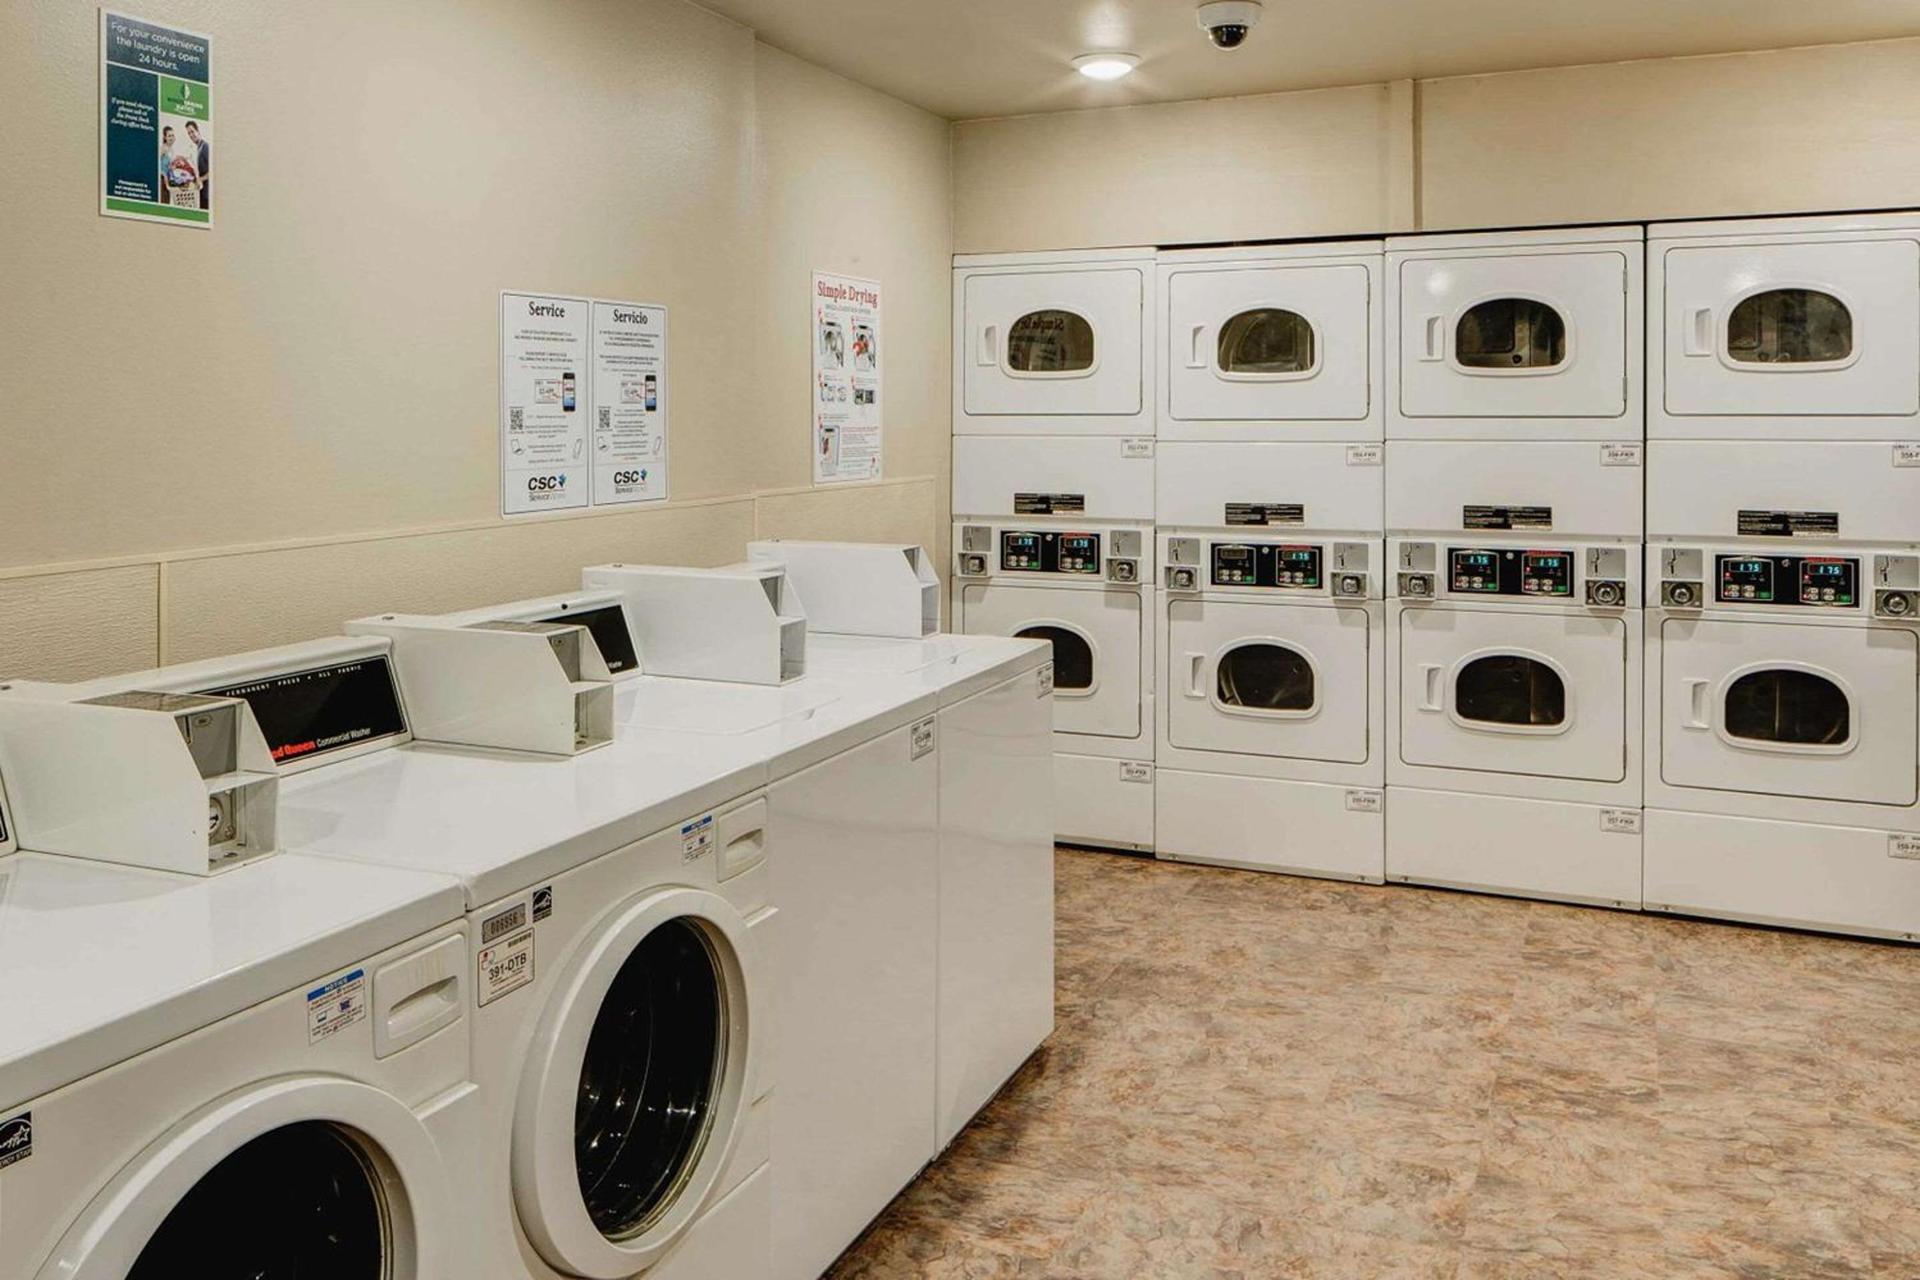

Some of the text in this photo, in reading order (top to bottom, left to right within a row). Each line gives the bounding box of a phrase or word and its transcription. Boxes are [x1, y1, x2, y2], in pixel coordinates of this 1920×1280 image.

[111, 21, 205, 53] For your convenience
[116, 36, 200, 64] the laundry is open
[138, 53, 179, 71] 24 hours.
[817, 280, 847, 303] Simple
[848, 286, 878, 309] Drying
[528, 301, 566, 318] Service
[613, 308, 649, 325] Servicio
[528, 475, 557, 491] CSC
[613, 470, 640, 484] CSC
[226, 683, 269, 697] PERMANENT
[278, 677, 300, 686] PRESS
[272, 727, 371, 759] ed Queen Commercial Washer
[488, 952, 527, 981] 391-DTB
